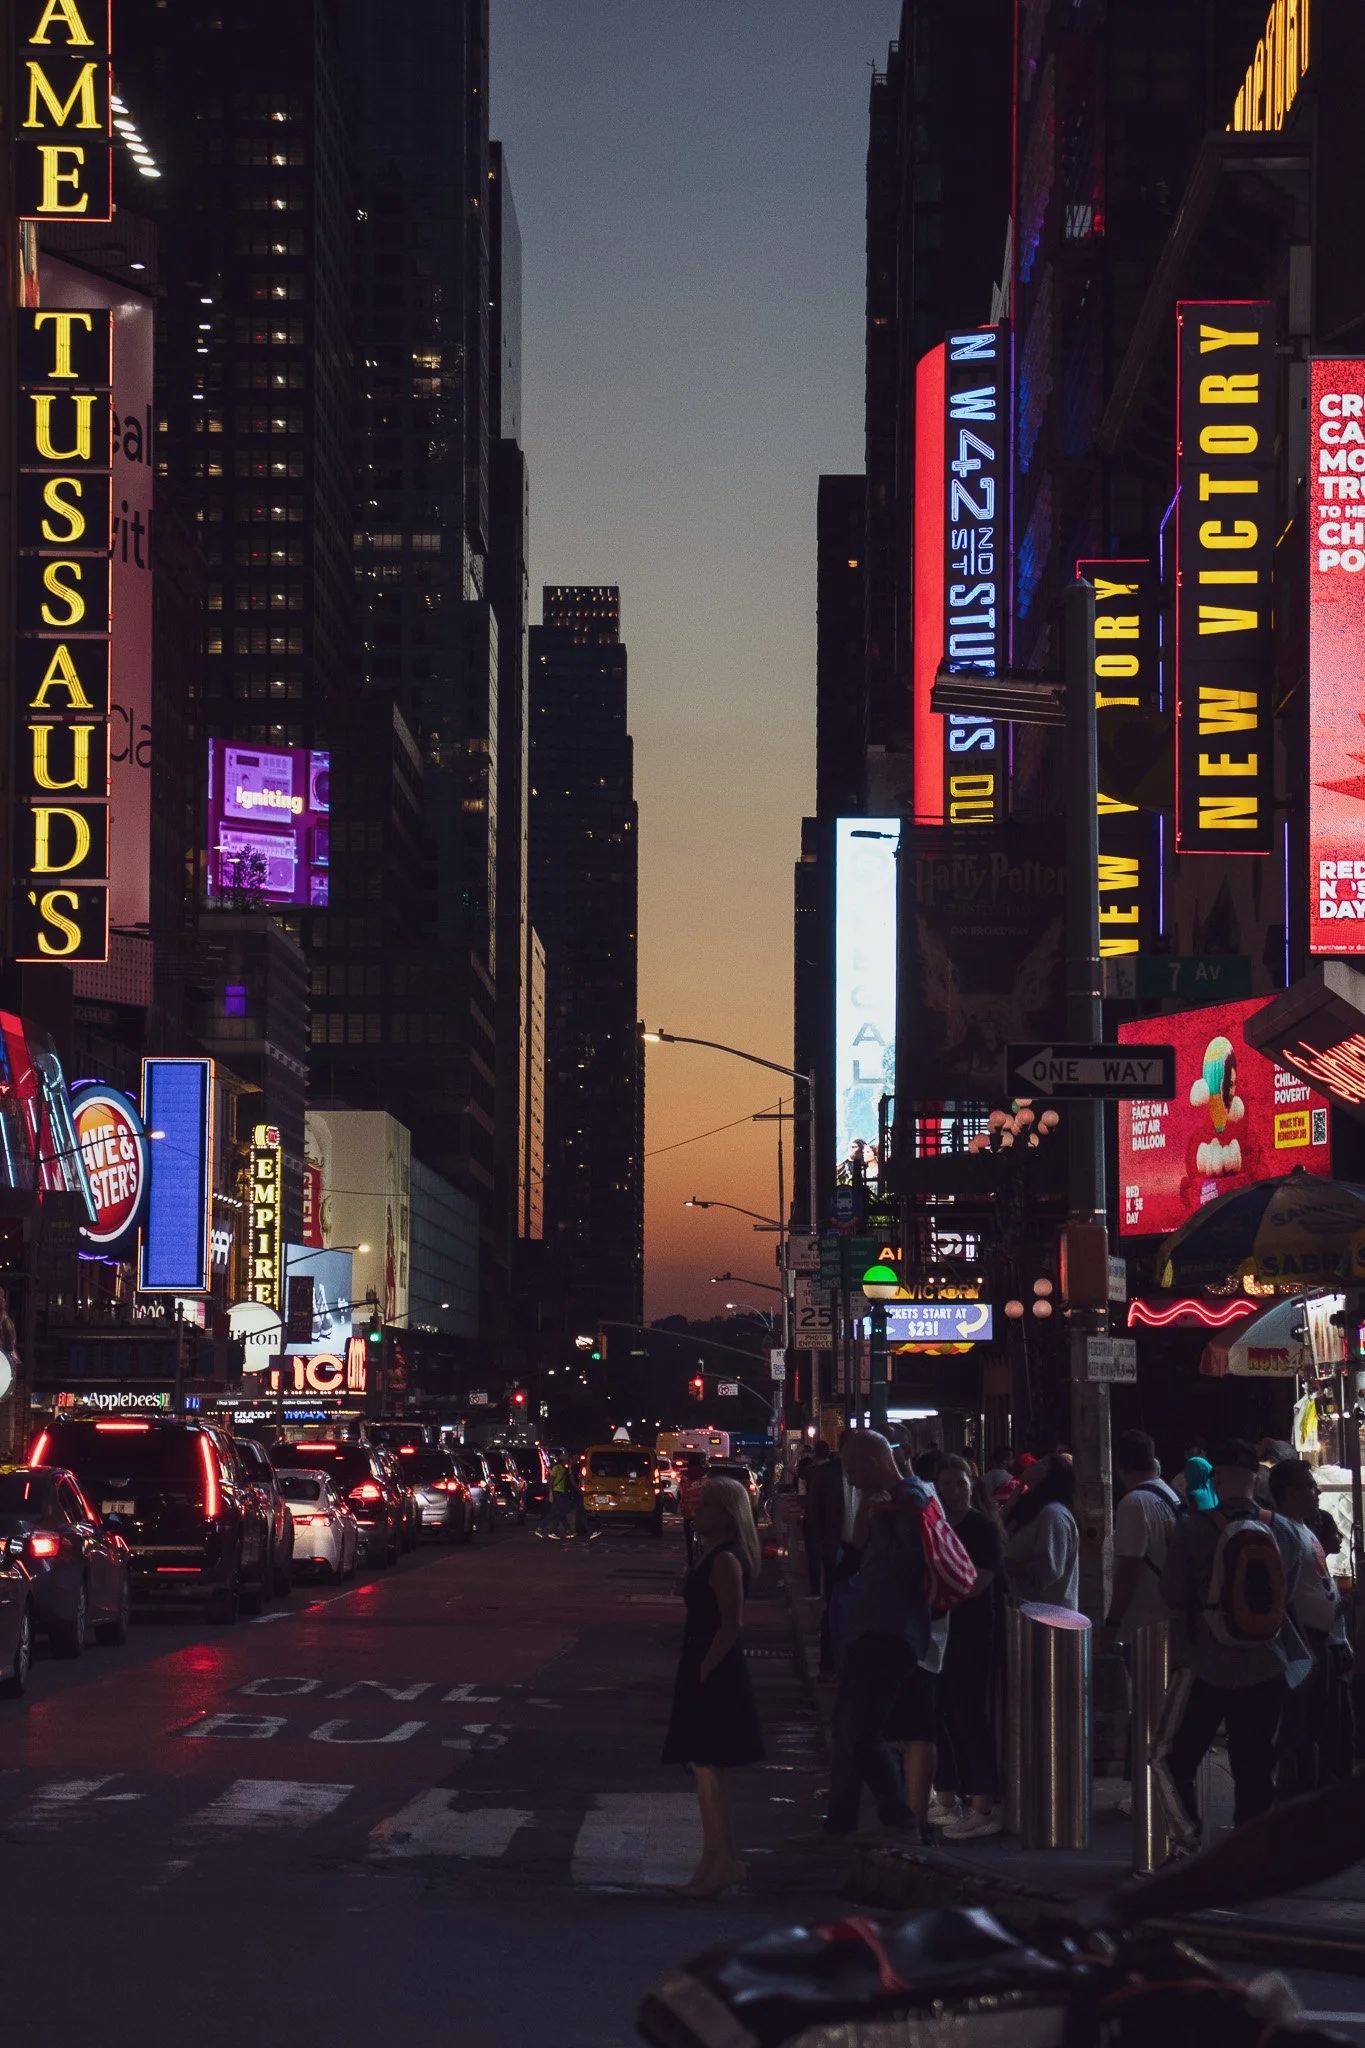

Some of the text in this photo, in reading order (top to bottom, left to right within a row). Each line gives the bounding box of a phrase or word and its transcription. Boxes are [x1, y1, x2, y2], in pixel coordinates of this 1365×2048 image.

[1319, 394, 1365, 417] CR
[951, 428, 995, 522] 42
[1318, 505, 1341, 519] TO
[1198, 324, 1259, 829] NEW VICTORY
[27, 311, 99, 957] TUSSAUD'S
[950, 582, 996, 753] STUS
[1094, 577, 1139, 815] VTORY
[236, 786, 304, 815] Igniting
[1168, 962, 1221, 993] 7 Av
[1032, 1062, 1153, 1082] ONE WAY
[1274, 1086, 1311, 1105] POVERTY
[1132, 1105, 1150, 1120] FACE
[1132, 1119, 1161, 1136] HOT AIR
[81, 1124, 120, 1171] AVE
[1132, 1134, 1166, 1152] BALLOON
[90, 1161, 137, 1210] STER'S
[253, 1158, 276, 1304] EMPIRE
[800, 1307, 831, 1332] 25
[887, 1308, 968, 1320] CKETS START AT
[87, 1392, 160, 1411] Applebee's
